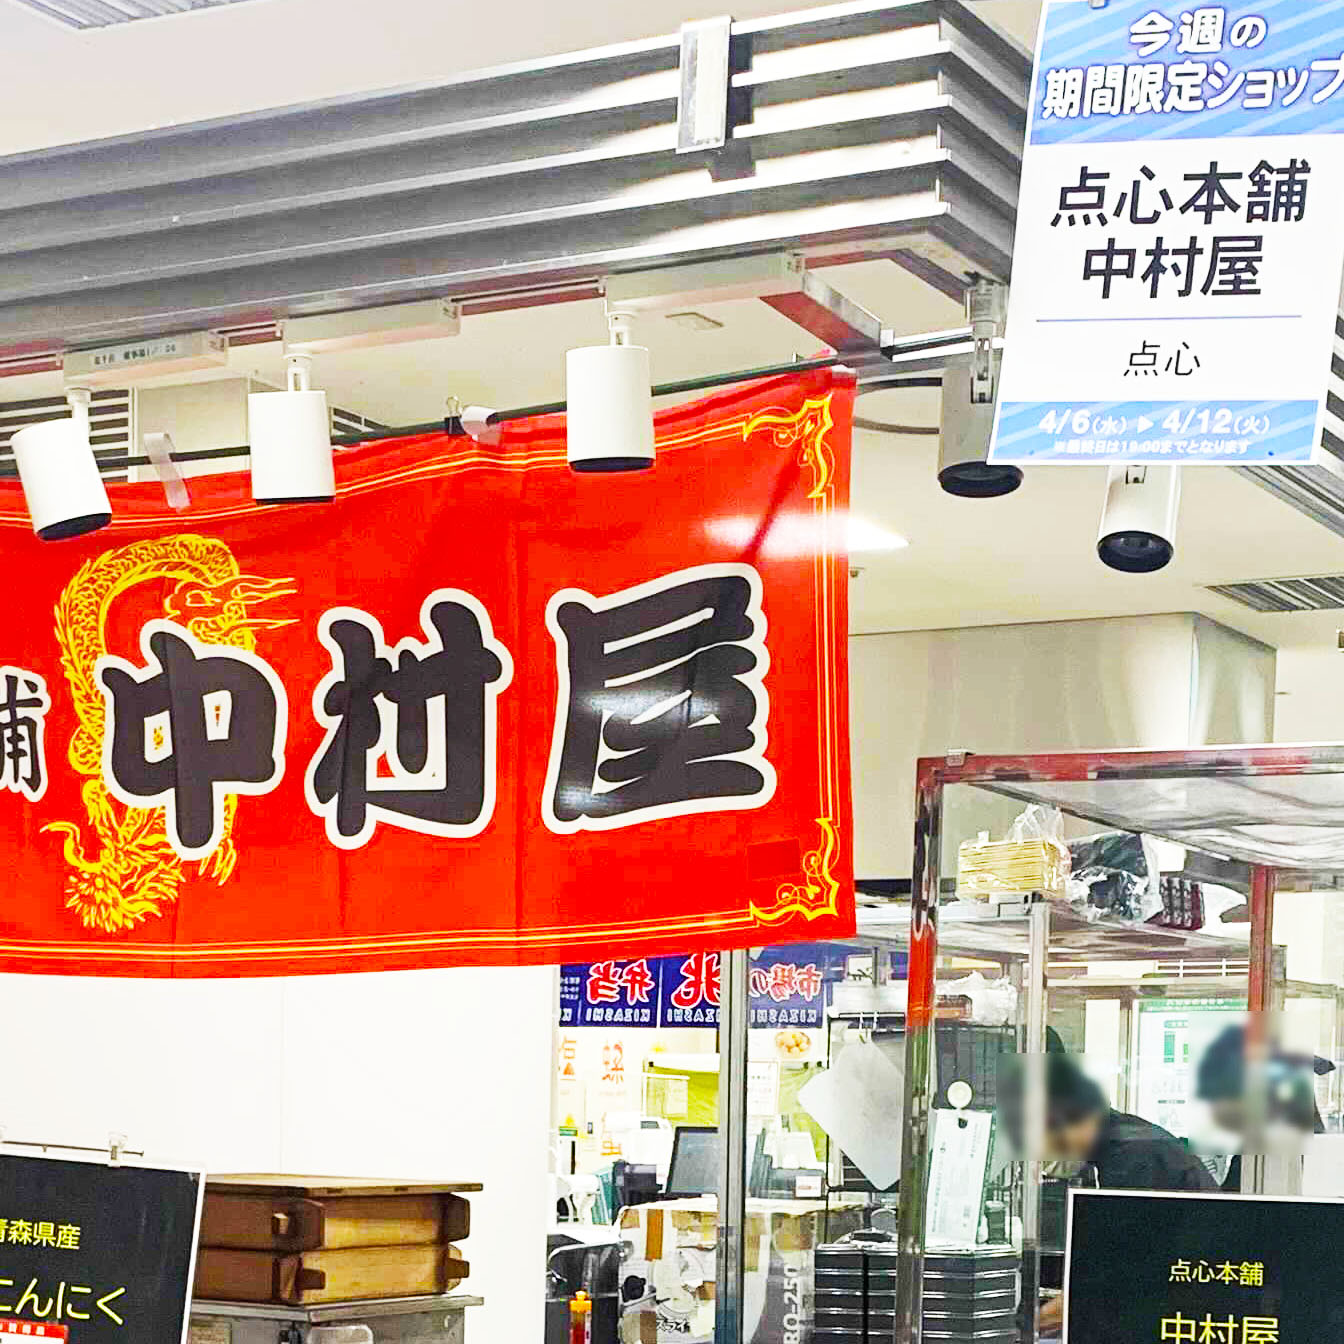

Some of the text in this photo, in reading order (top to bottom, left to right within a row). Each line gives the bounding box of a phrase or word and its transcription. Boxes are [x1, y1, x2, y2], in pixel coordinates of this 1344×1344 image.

[1130, 7, 1267, 57] 今週の
[1051, 158, 1311, 228] 点心本舗
[1082, 235, 1263, 299] 中村屋
[1124, 340, 1200, 377] 点心
[99, 561, 777, 860] 中村屋
[1167, 1259, 1265, 1287] 点心本舗
